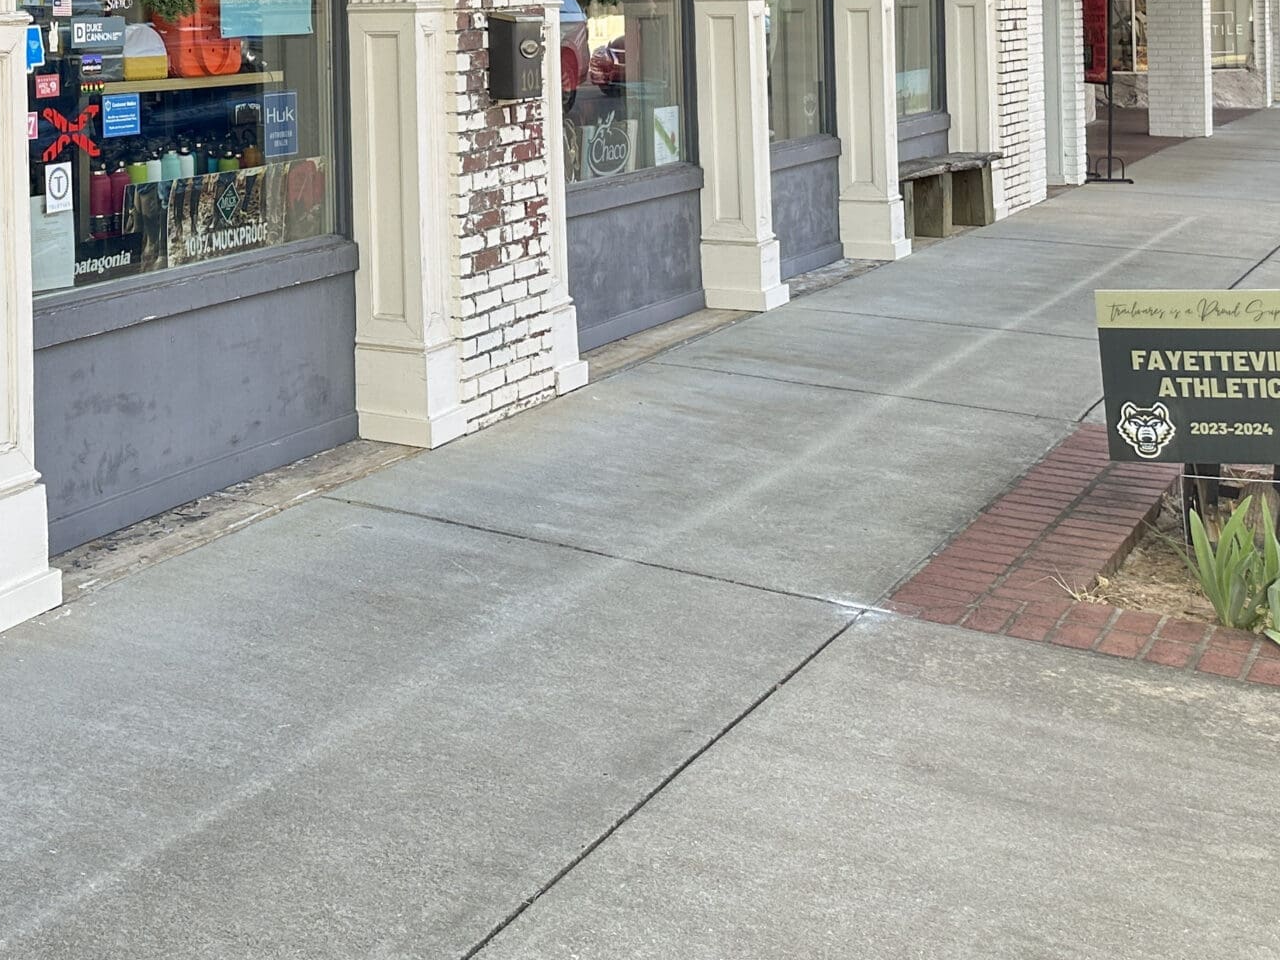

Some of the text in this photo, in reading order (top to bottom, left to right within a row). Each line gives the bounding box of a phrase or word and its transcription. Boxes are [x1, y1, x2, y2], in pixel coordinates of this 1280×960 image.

[86, 23, 103, 32] DUKE
[86, 32, 113, 42] CANNON
[592, 137, 626, 163] Chaco
[185, 221, 269, 258] 100% MUCKPROOF
[1197, 298, 1241, 322] Proud
[1190, 422, 1273, 436] 2023-2024
